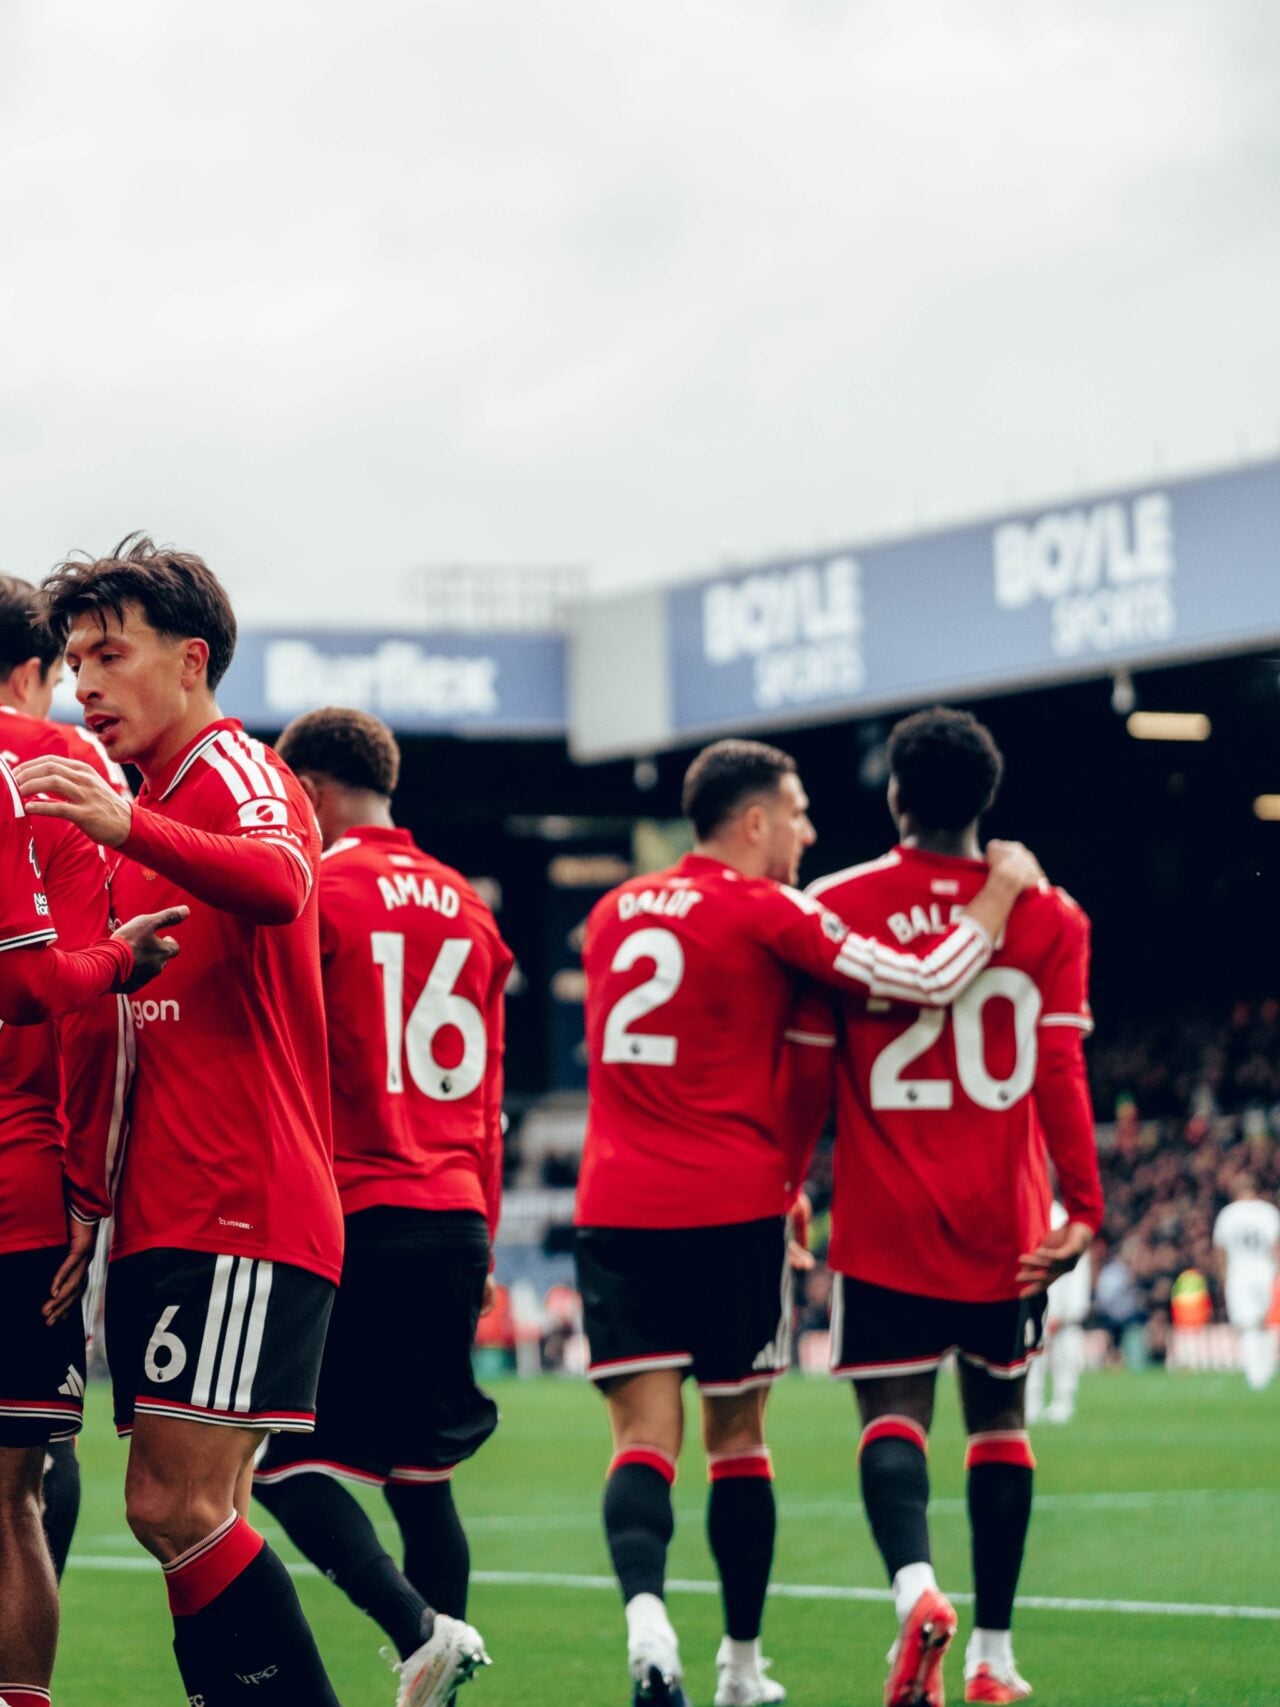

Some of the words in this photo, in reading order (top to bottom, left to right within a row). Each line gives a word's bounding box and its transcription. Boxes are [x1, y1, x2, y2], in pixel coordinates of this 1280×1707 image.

[376, 873, 459, 918] AMAD
[370, 932, 487, 1101] 16
[602, 928, 684, 1066] 2
[867, 967, 1042, 1113] 20
[144, 1305, 187, 1383] 6
